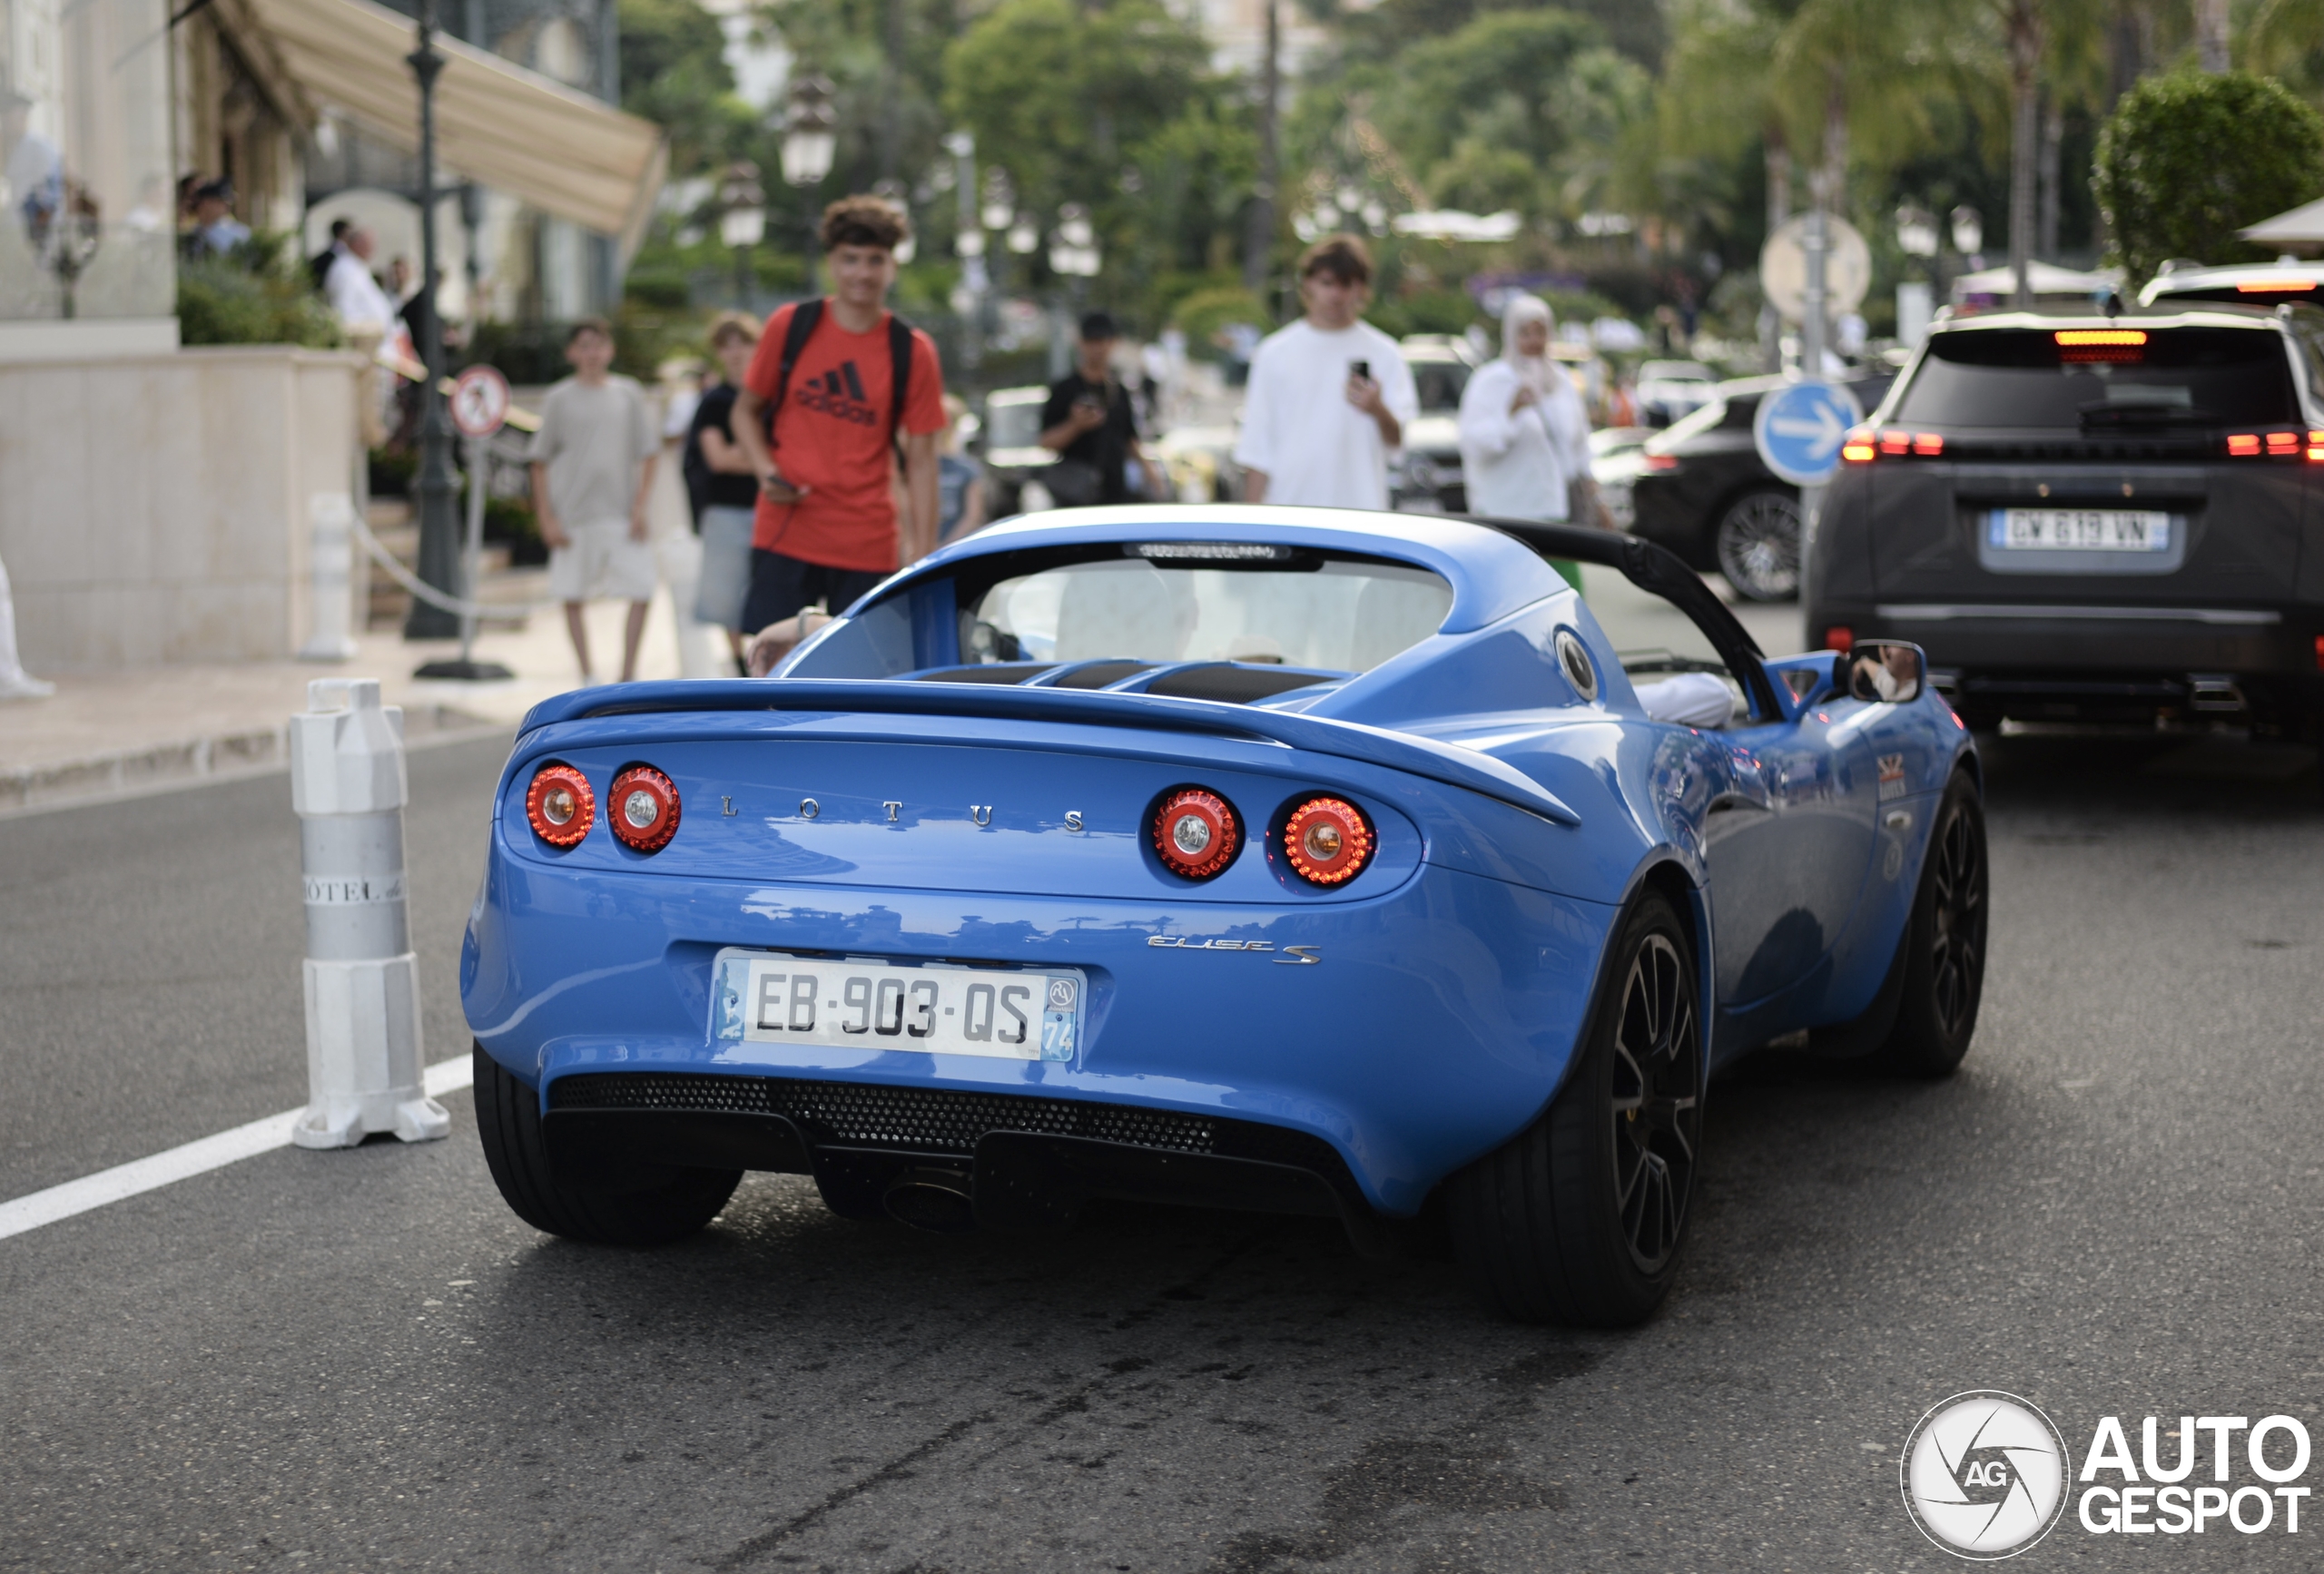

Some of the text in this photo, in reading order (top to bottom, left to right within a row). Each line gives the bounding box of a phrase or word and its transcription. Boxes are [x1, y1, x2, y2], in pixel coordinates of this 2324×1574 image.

[721, 795, 1084, 832] LOTUS
[1272, 946, 1321, 965] S
[756, 973, 1031, 1044] EB-903-QS
[1044, 1021, 1073, 1051] 74
